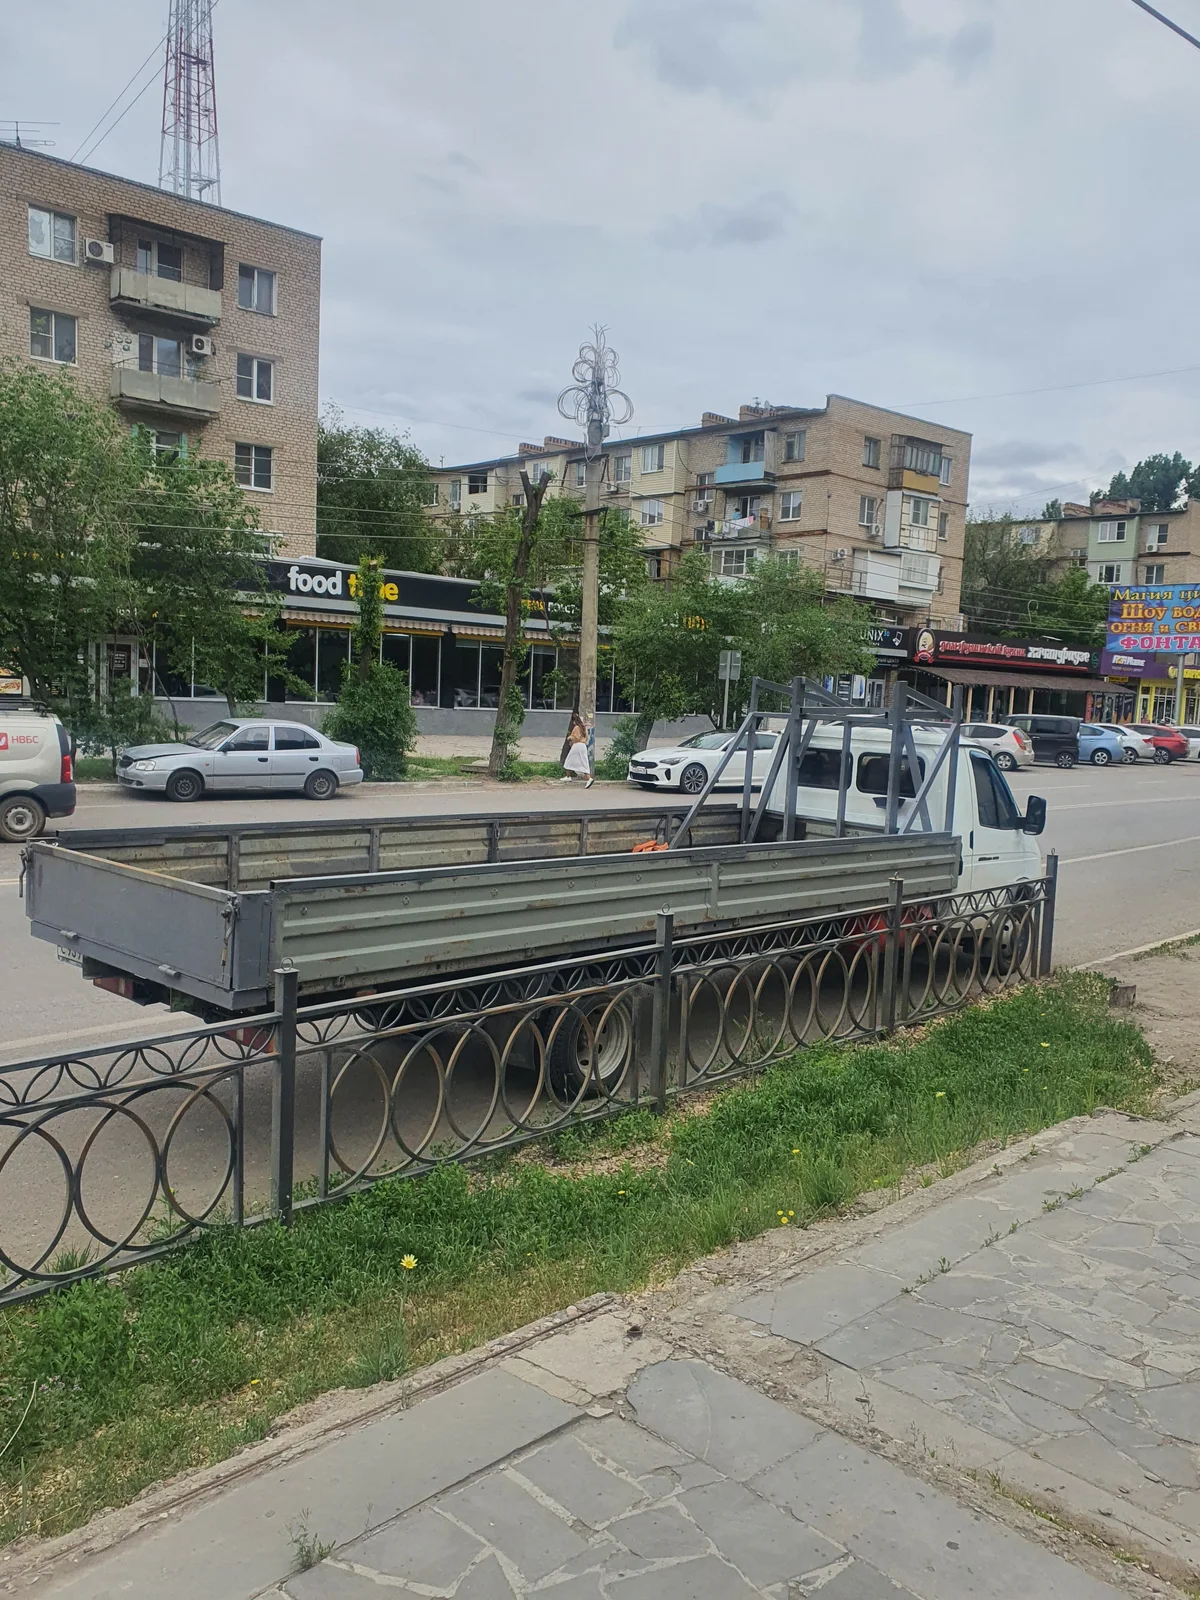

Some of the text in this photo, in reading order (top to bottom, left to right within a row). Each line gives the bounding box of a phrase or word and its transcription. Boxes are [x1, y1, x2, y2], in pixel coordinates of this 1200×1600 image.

[287, 565, 342, 595] food
[1113, 589, 1173, 600] Магия
[1121, 603, 1168, 620] Шоу
[11, 735, 39, 744] НВБС
